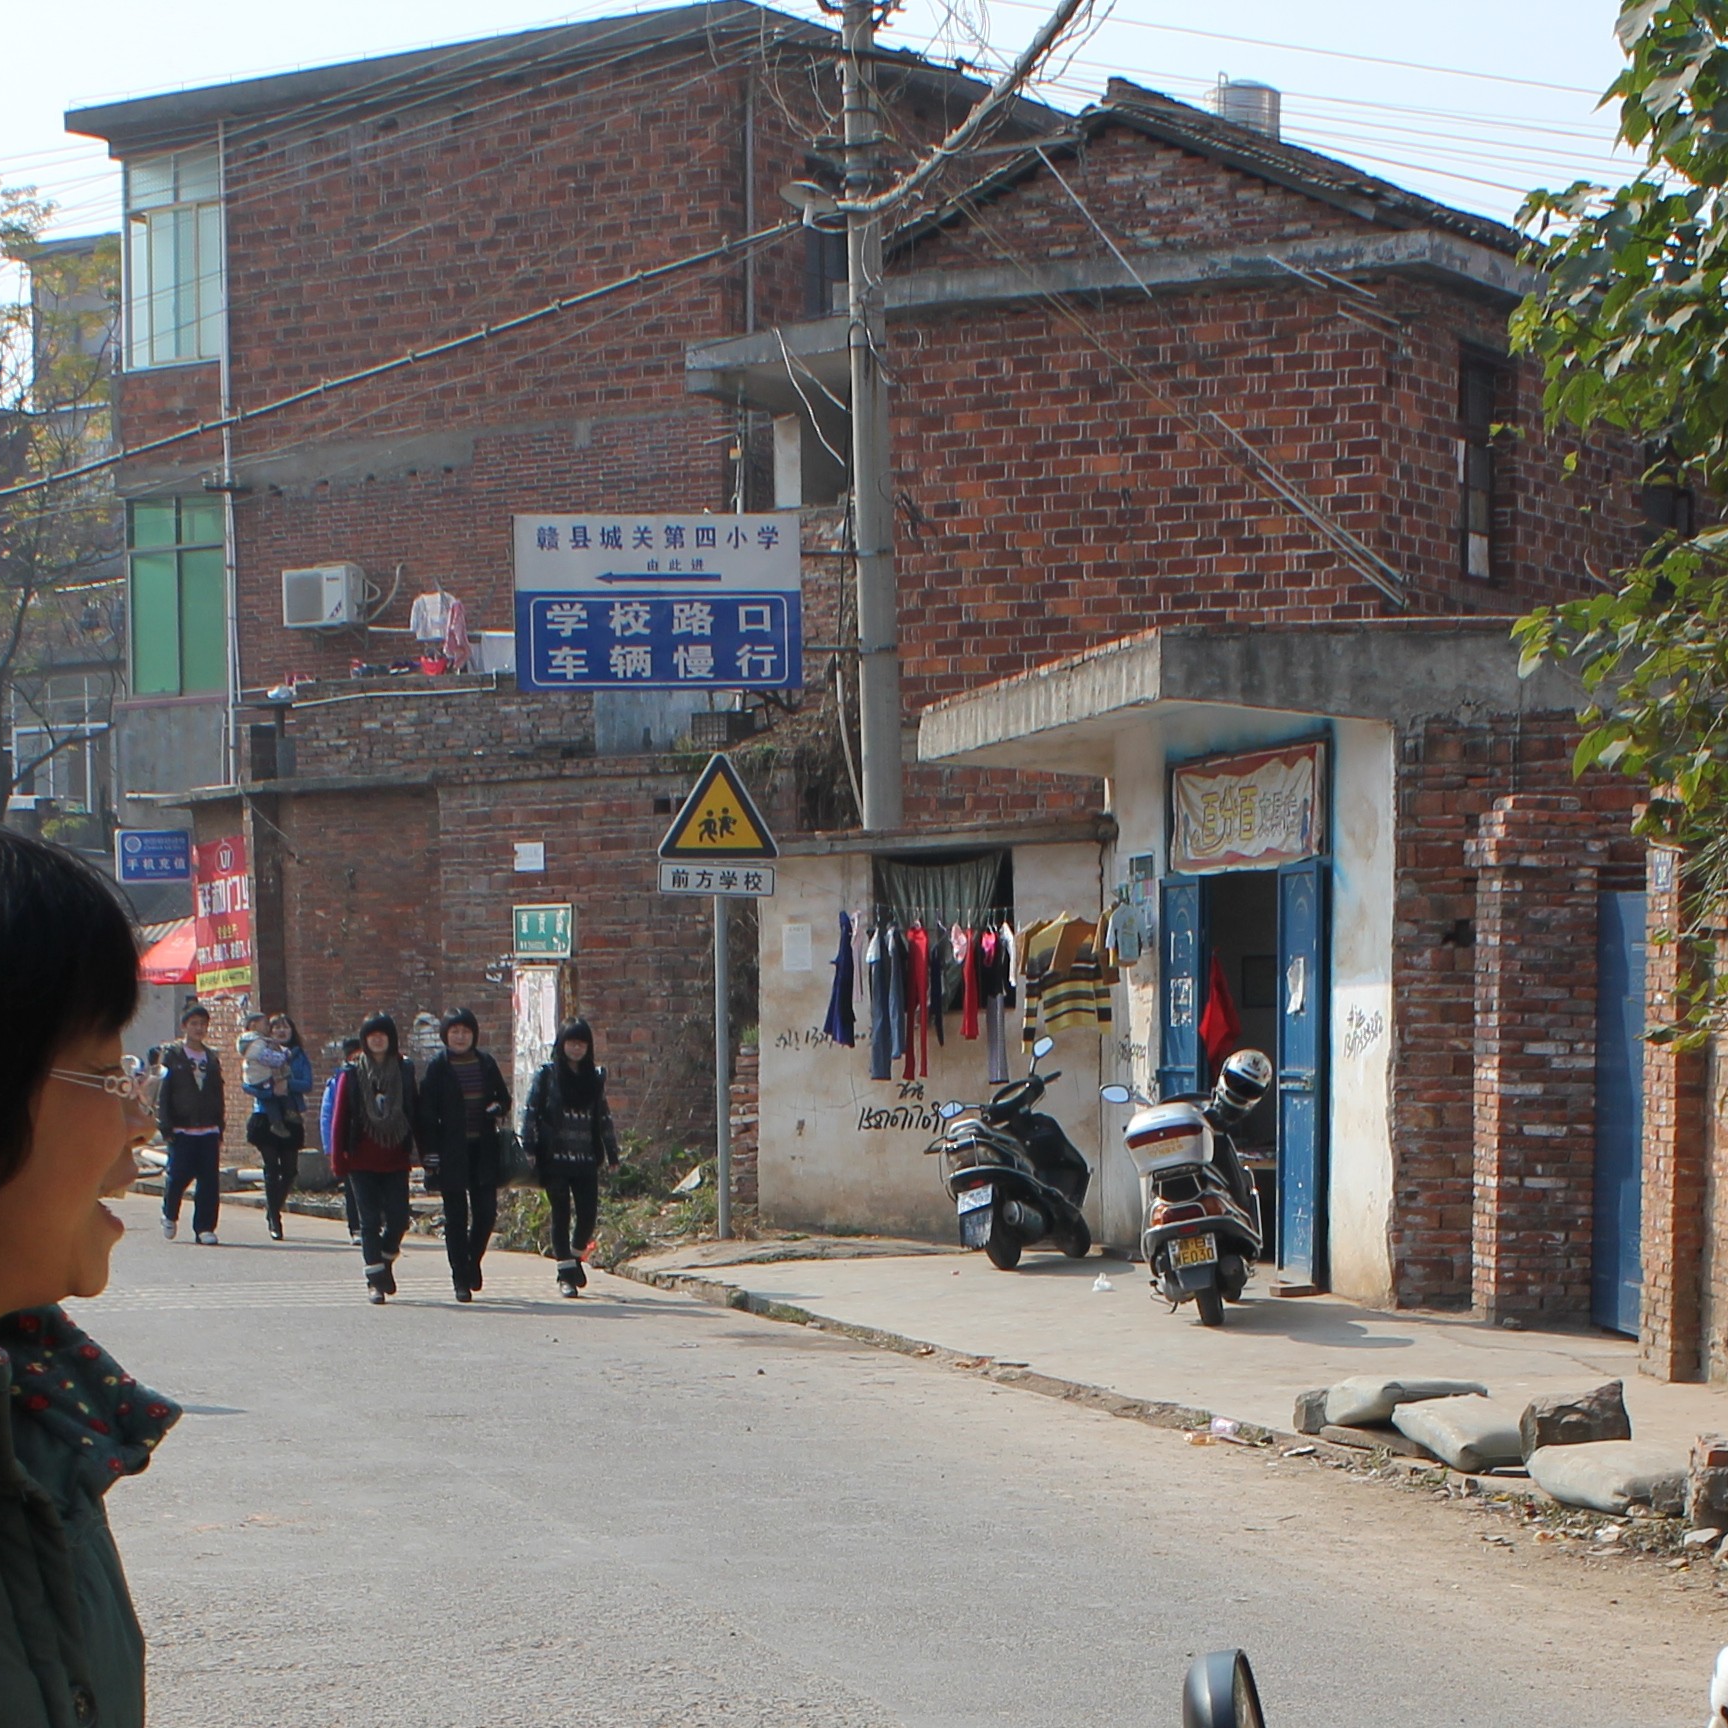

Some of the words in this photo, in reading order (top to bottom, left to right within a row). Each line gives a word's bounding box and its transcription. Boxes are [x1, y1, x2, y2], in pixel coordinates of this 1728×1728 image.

[536, 525, 780, 551] 赣县城关第四小学
[647, 558, 705, 572] 由此进
[546, 602, 772, 638] 学校路口
[547, 644, 778, 680] 车辆慢行
[671, 869, 763, 891] 前方学校
